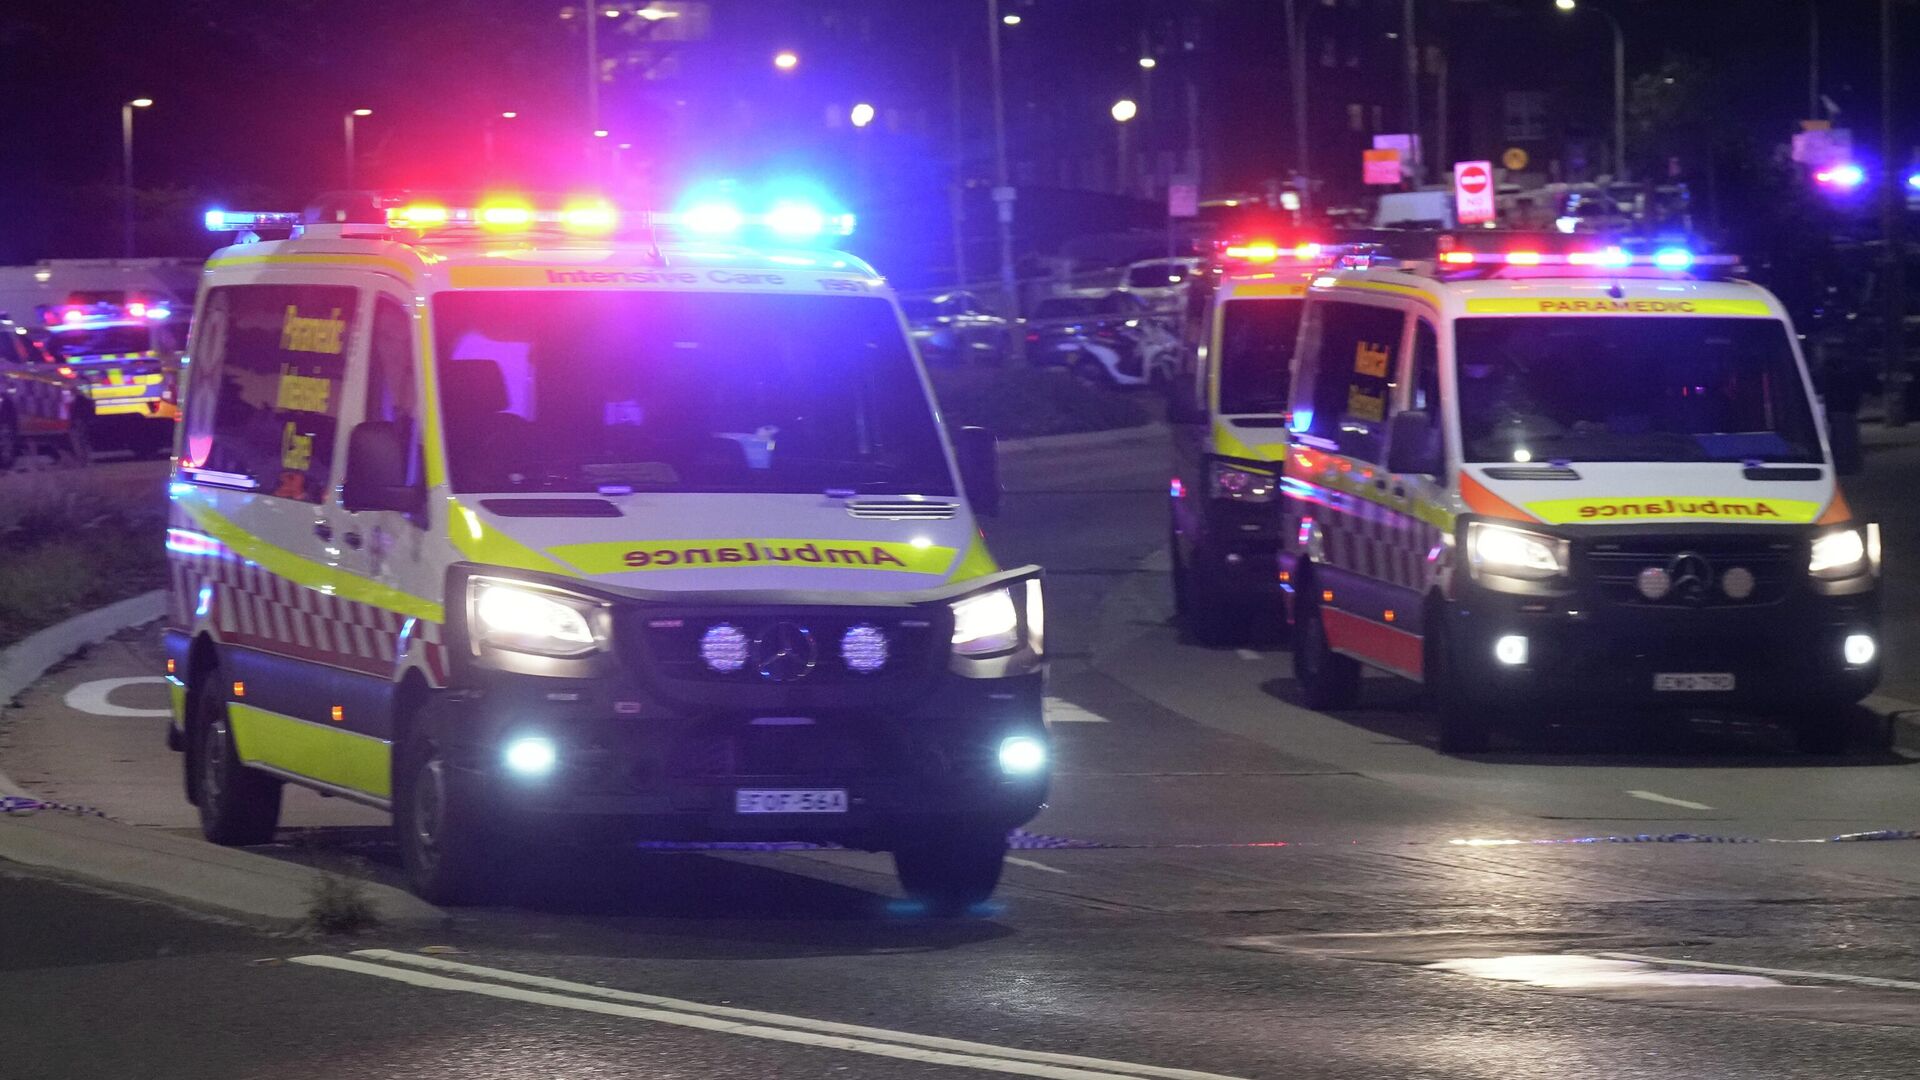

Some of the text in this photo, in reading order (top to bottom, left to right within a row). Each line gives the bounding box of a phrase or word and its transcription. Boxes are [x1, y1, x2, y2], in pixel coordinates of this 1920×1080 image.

[545, 269, 784, 286] Intensive Care
[1539, 300, 1696, 313] PARAMEDIC
